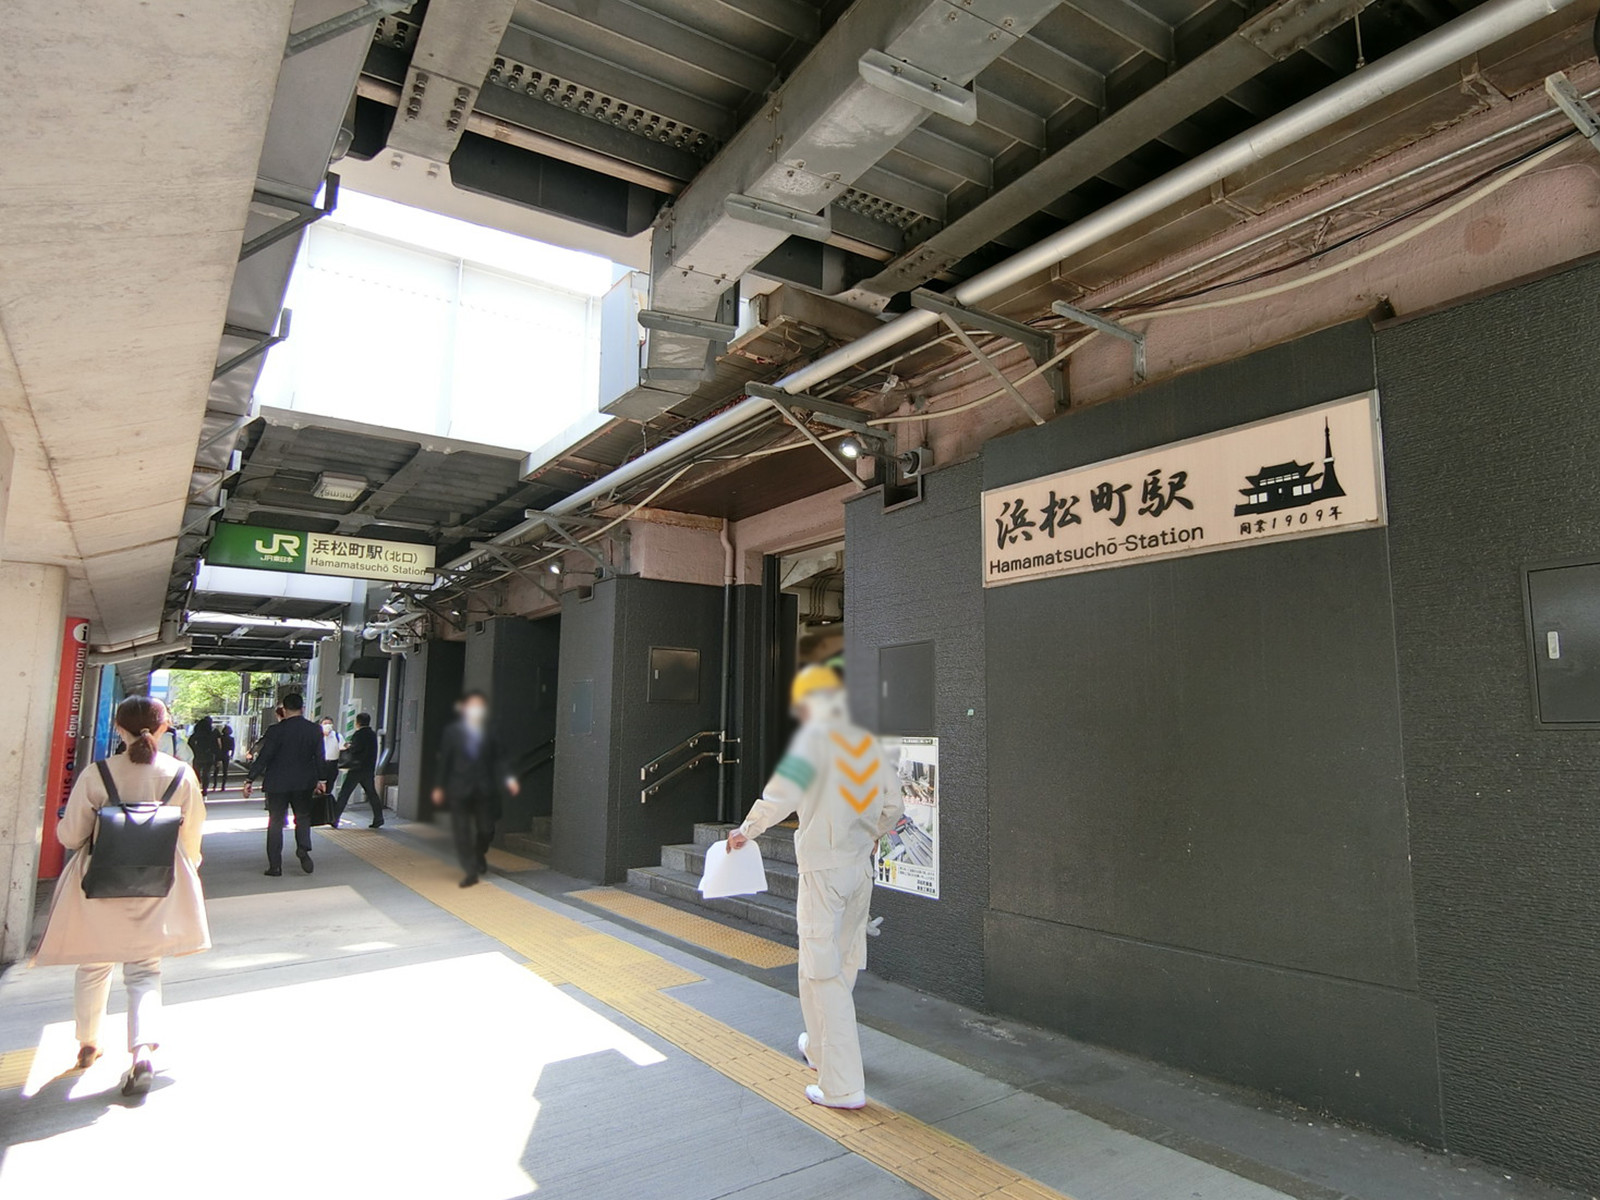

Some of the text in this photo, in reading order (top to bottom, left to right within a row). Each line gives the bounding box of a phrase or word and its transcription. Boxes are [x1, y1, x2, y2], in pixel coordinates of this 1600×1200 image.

[995, 468, 1194, 550] 浜松町駅
[255, 533, 301, 557] JR
[260, 554, 294, 563] JR東日本
[392, 564, 427, 576] Station
[65, 647, 87, 738] Information Map
